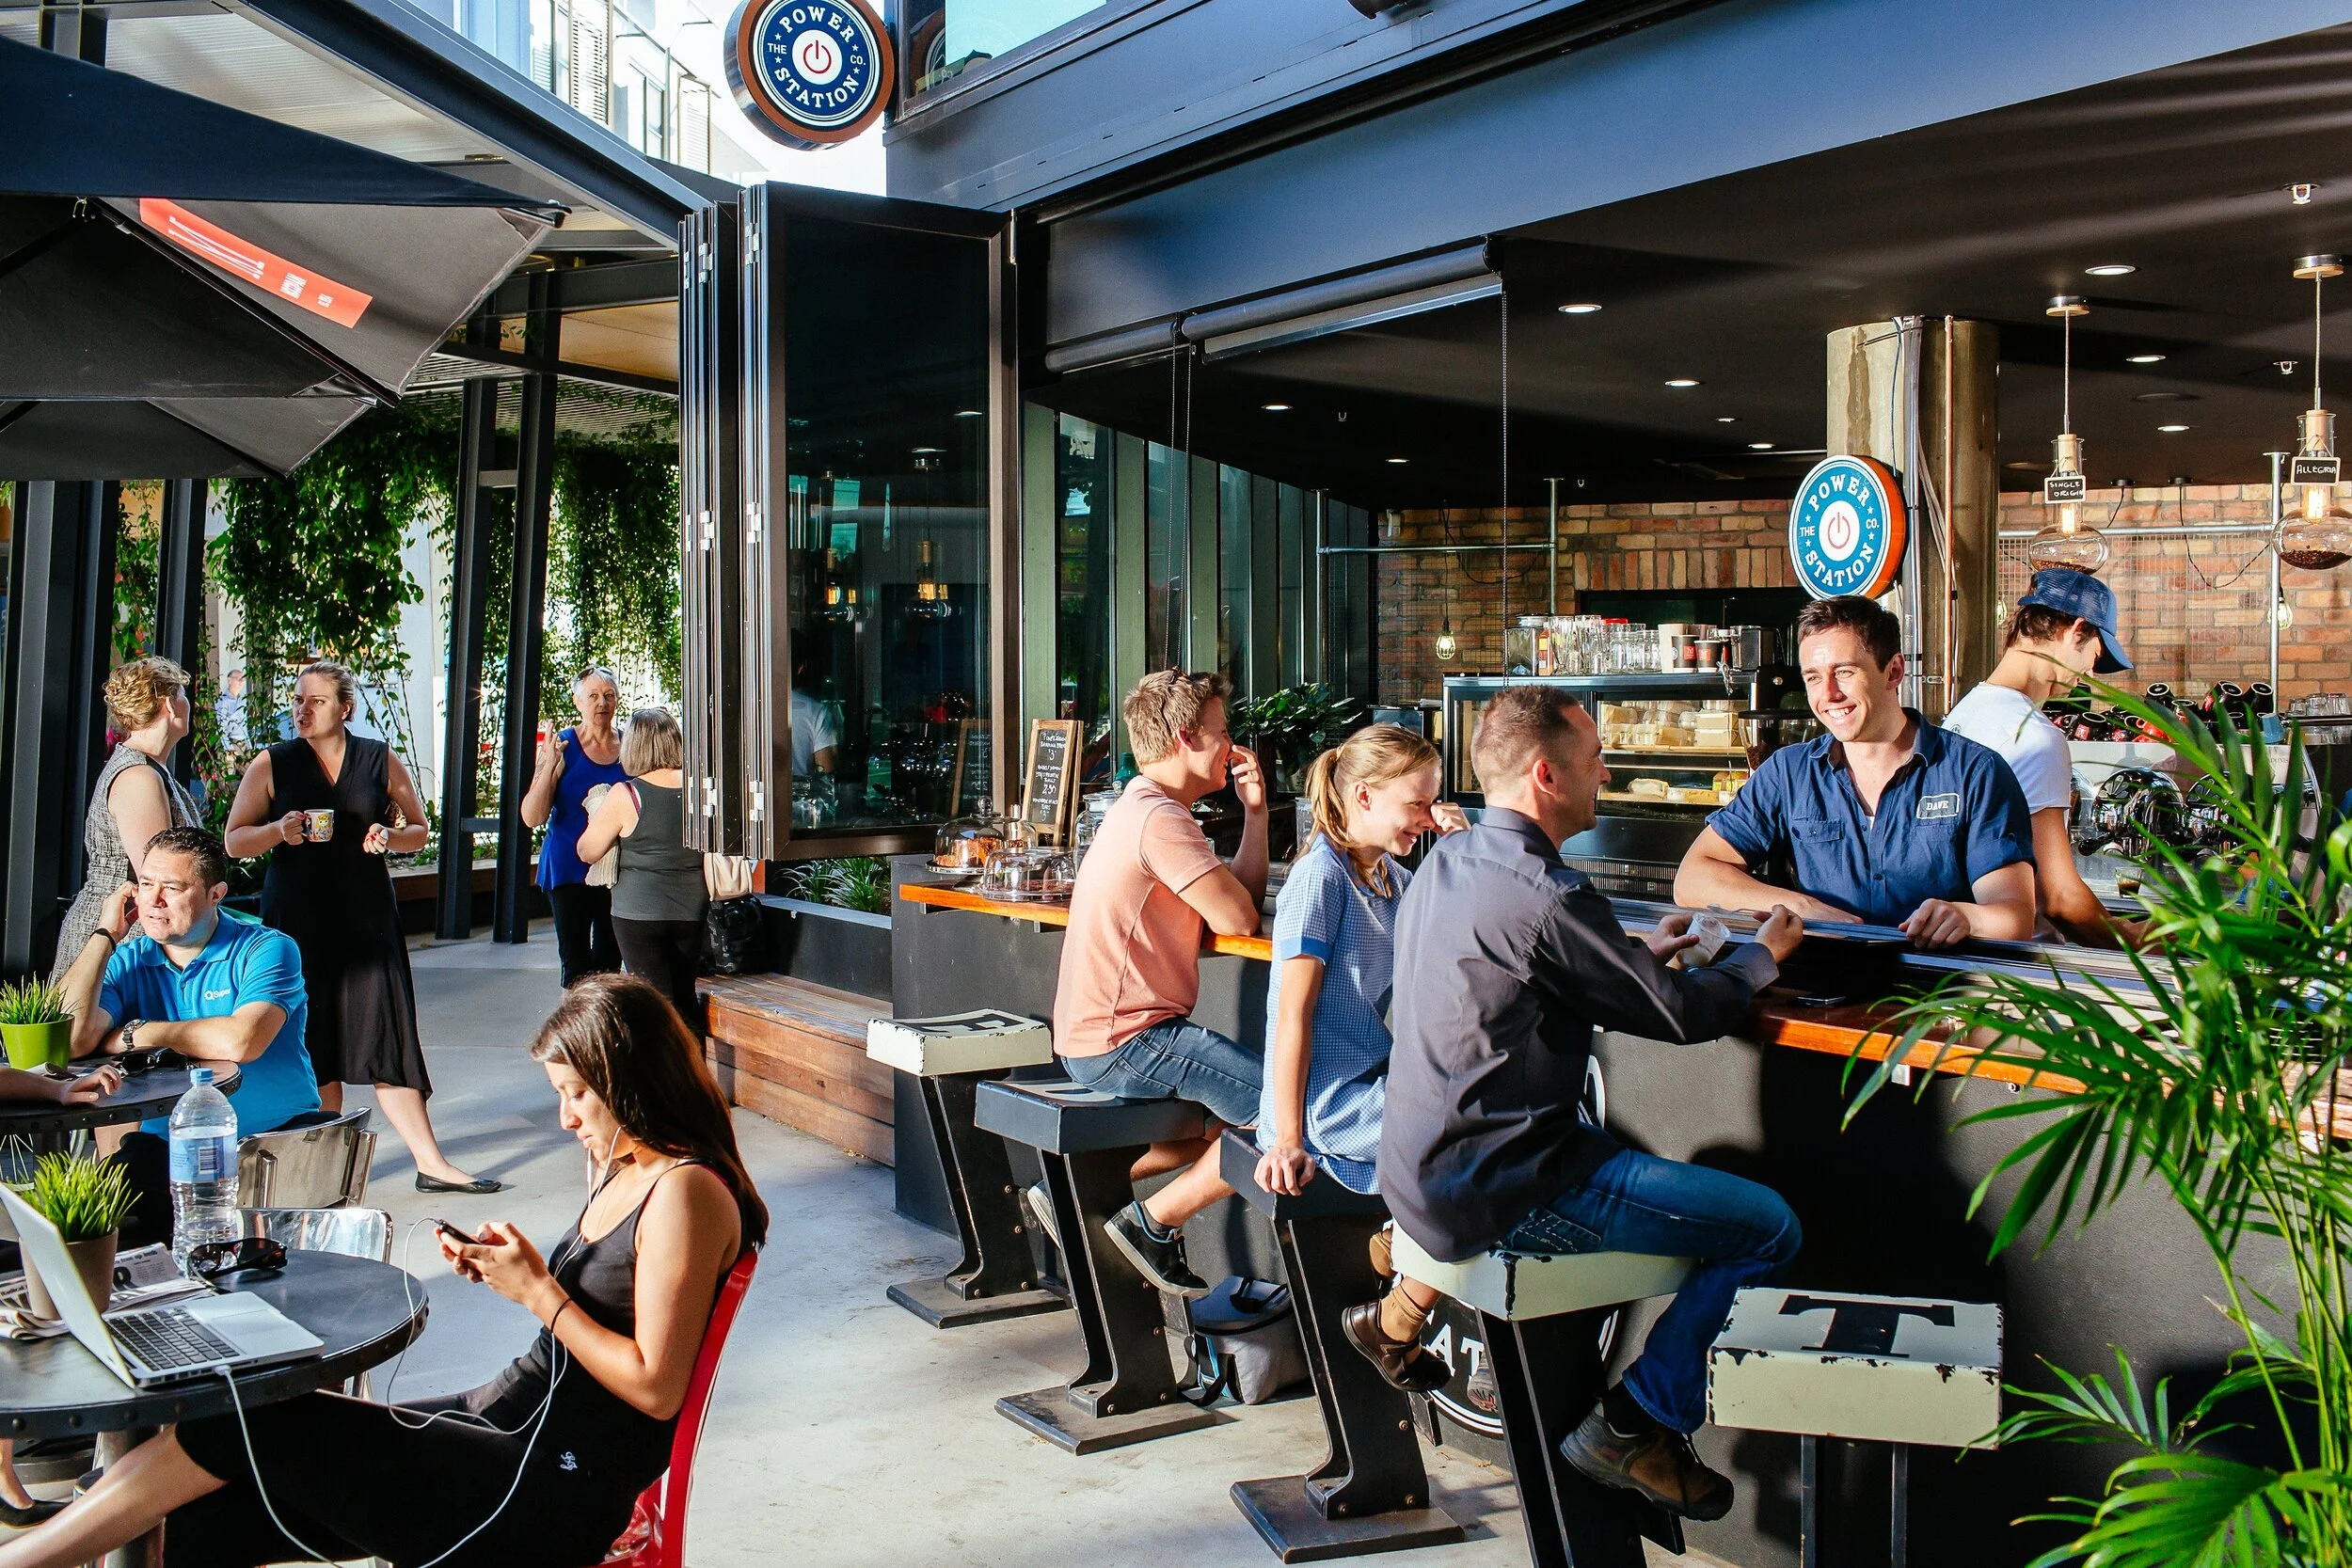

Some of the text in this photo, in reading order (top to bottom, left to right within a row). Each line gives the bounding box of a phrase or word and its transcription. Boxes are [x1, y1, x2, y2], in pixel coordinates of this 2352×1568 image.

[779, 6, 855, 43] POWER
[767, 42, 787, 55] THE
[850, 54, 866, 66] CO.
[774, 67, 860, 108] STATION
[2296, 464, 2337, 474] ALLEGRIA
[1807, 473, 1870, 513] POWER
[2053, 489, 2084, 498] ORIGIN
[1866, 518, 1880, 530] CO.
[1799, 525, 1816, 537] THE
[1804, 542, 1875, 588] STATION
[1926, 800, 1949, 811] DAVE
[1779, 1294, 1956, 1358] T
